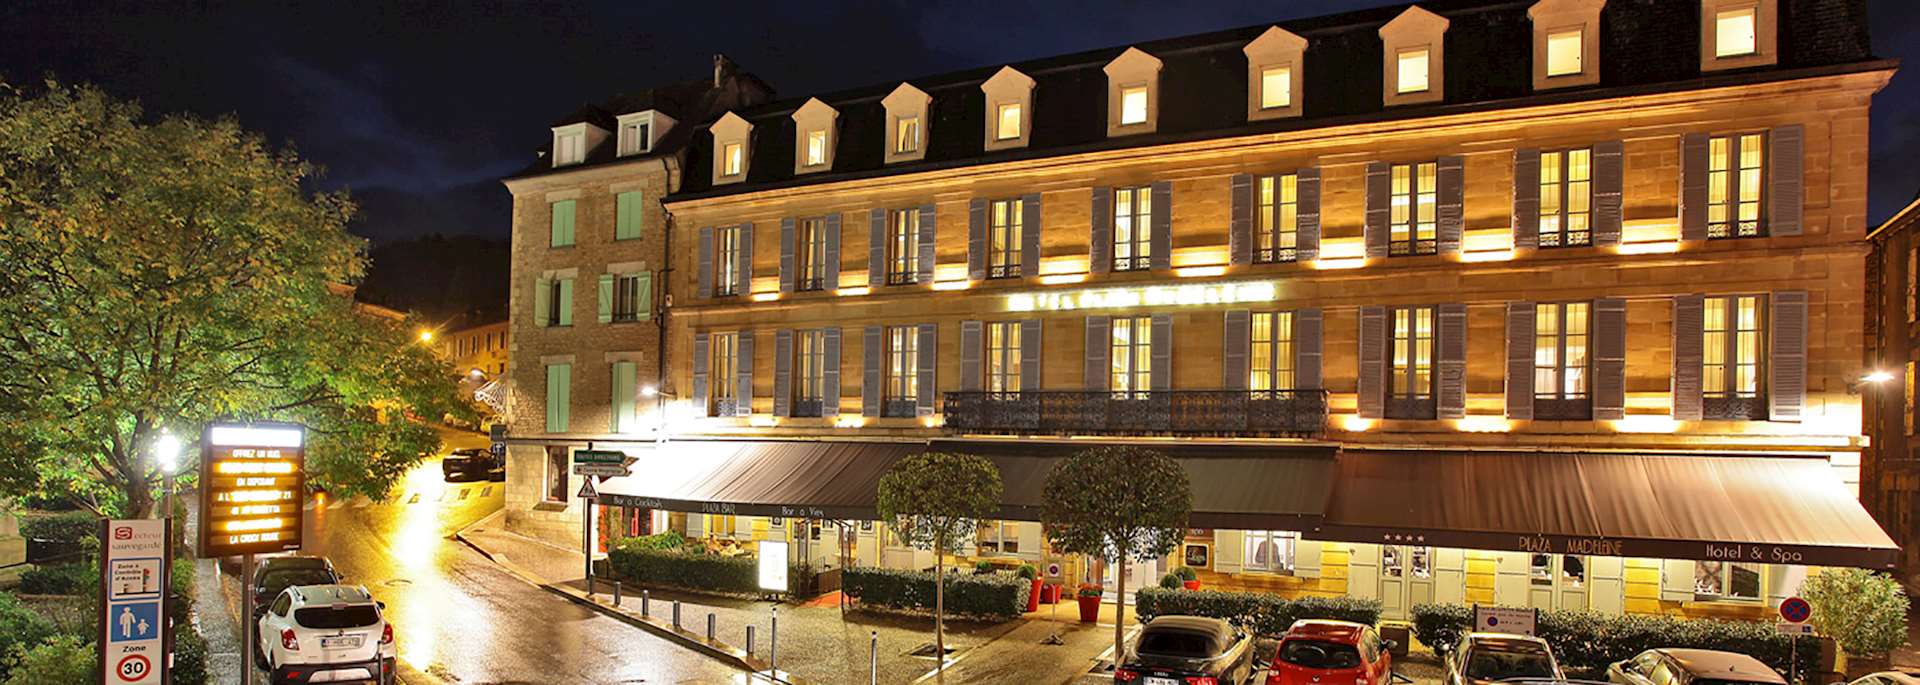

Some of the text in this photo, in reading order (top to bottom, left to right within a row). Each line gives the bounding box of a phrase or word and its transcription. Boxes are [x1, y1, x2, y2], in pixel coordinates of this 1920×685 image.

[1519, 536, 1623, 555] PLAZA MADELEINE
[1706, 544, 1802, 563] Hotel & Spa
[122, 645, 146, 653] Zone
[124, 662, 143, 675] 30
